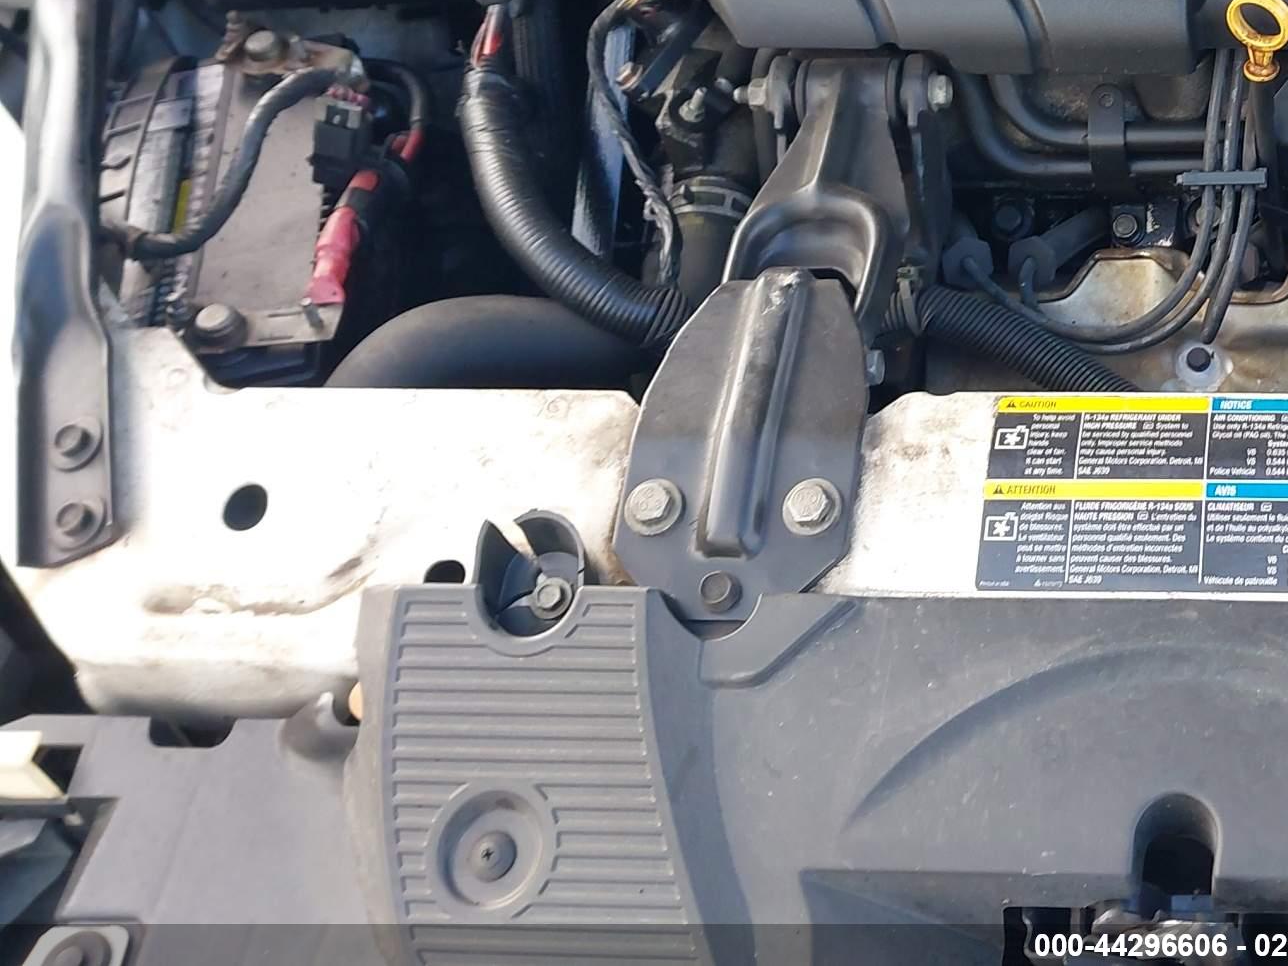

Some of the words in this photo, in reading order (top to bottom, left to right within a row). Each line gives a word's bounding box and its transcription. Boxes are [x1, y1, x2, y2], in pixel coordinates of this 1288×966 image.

[1220, 400, 1252, 410] NOTICE
[1042, 414, 1057, 422] help
[1030, 422, 1060, 430] personal
[1101, 421, 1136, 430] PRESSURE
[1079, 456, 1104, 464] General
[1105, 456, 1127, 464] Motors
[1032, 468, 1046, 476] any
[1210, 467, 1231, 475] Police
[1231, 467, 1256, 475] Vehicle
[1006, 485, 1056, 494] ATTENTION
[1215, 485, 1236, 496] AVIS
[1021, 502, 1052, 510] Attention
[1075, 501, 1099, 510] FLUIDE
[1208, 503, 1254, 511] CLIMATISEUR
[1074, 512, 1098, 521] HAUTE
[1099, 512, 1134, 521] PRESSION
[1232, 514, 1267, 522] seulement
[1070, 565, 1096, 573] General
[1097, 565, 1120, 573] Motors
[1069, 575, 1084, 583] SAE
